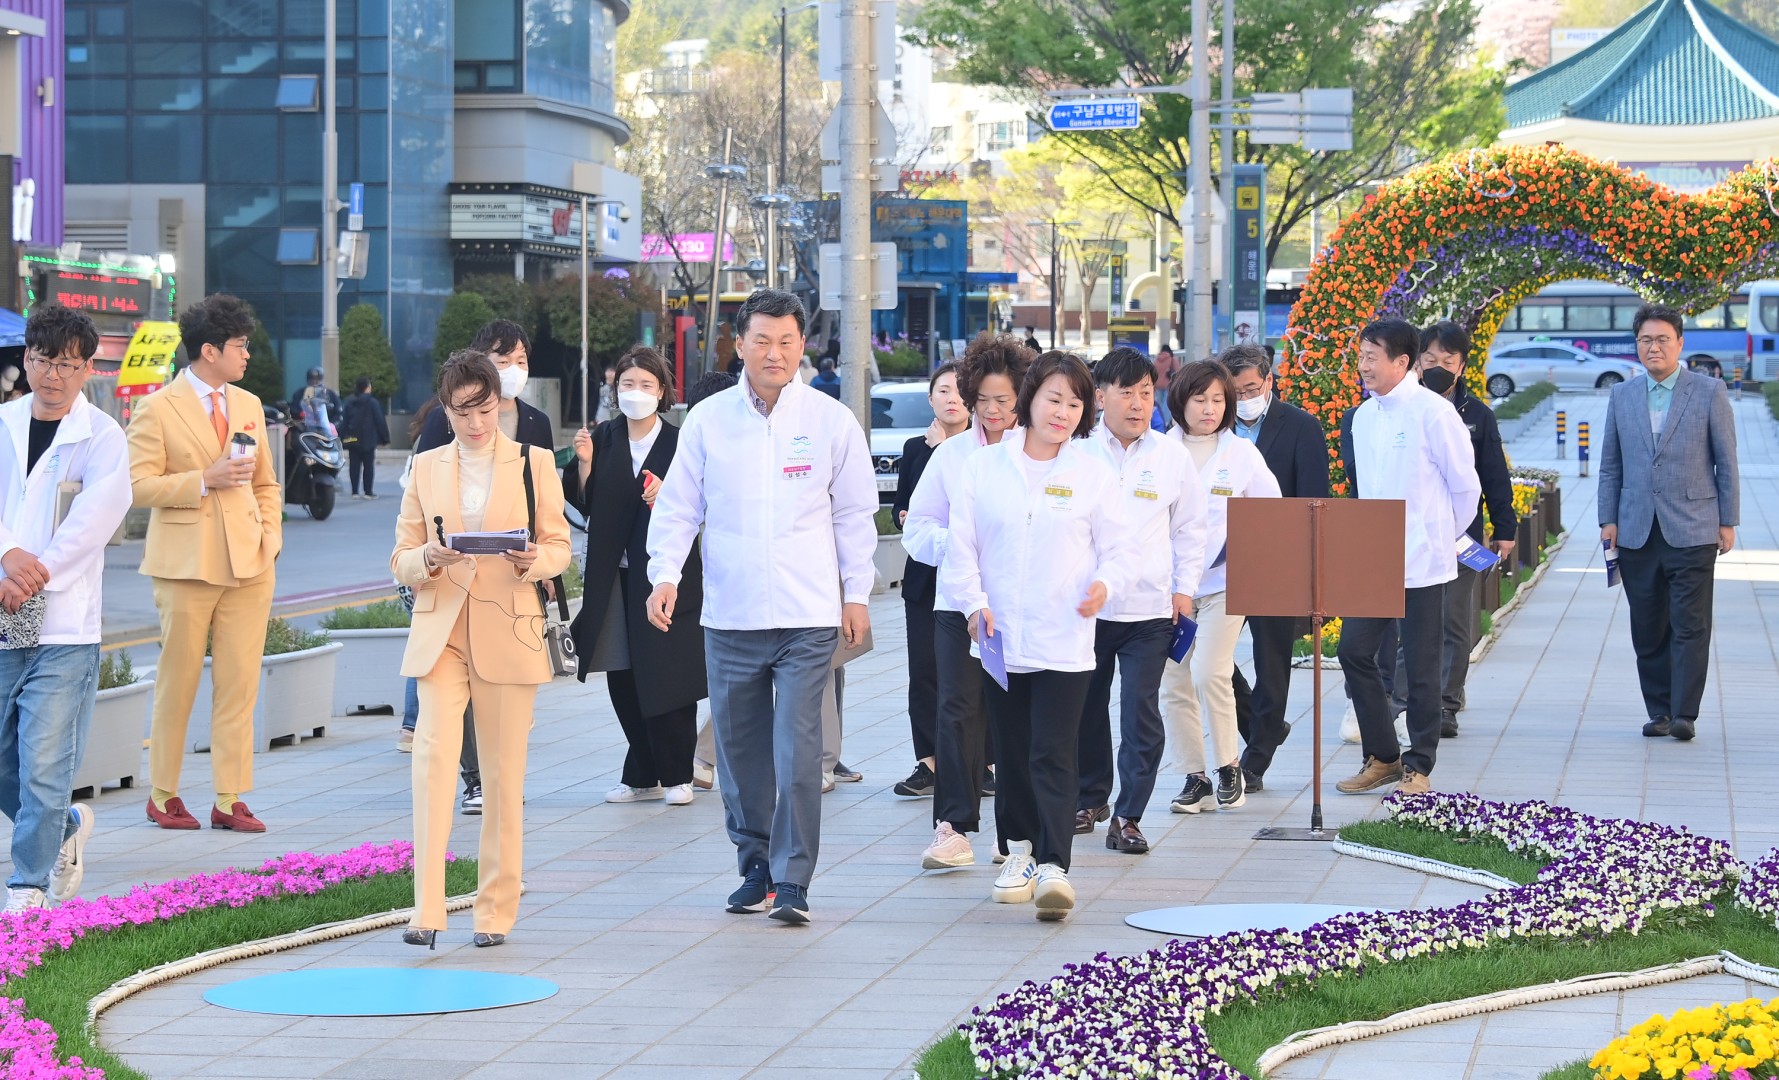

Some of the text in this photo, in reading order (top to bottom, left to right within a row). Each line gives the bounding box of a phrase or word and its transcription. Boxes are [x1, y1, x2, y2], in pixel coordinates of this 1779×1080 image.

[1072, 104, 1136, 119] 구남로8번길
[1069, 119, 1102, 128] Gunam-ro
[1247, 218, 1258, 239] 5
[136, 333, 177, 346] 사주
[127, 353, 167, 368] 타로
